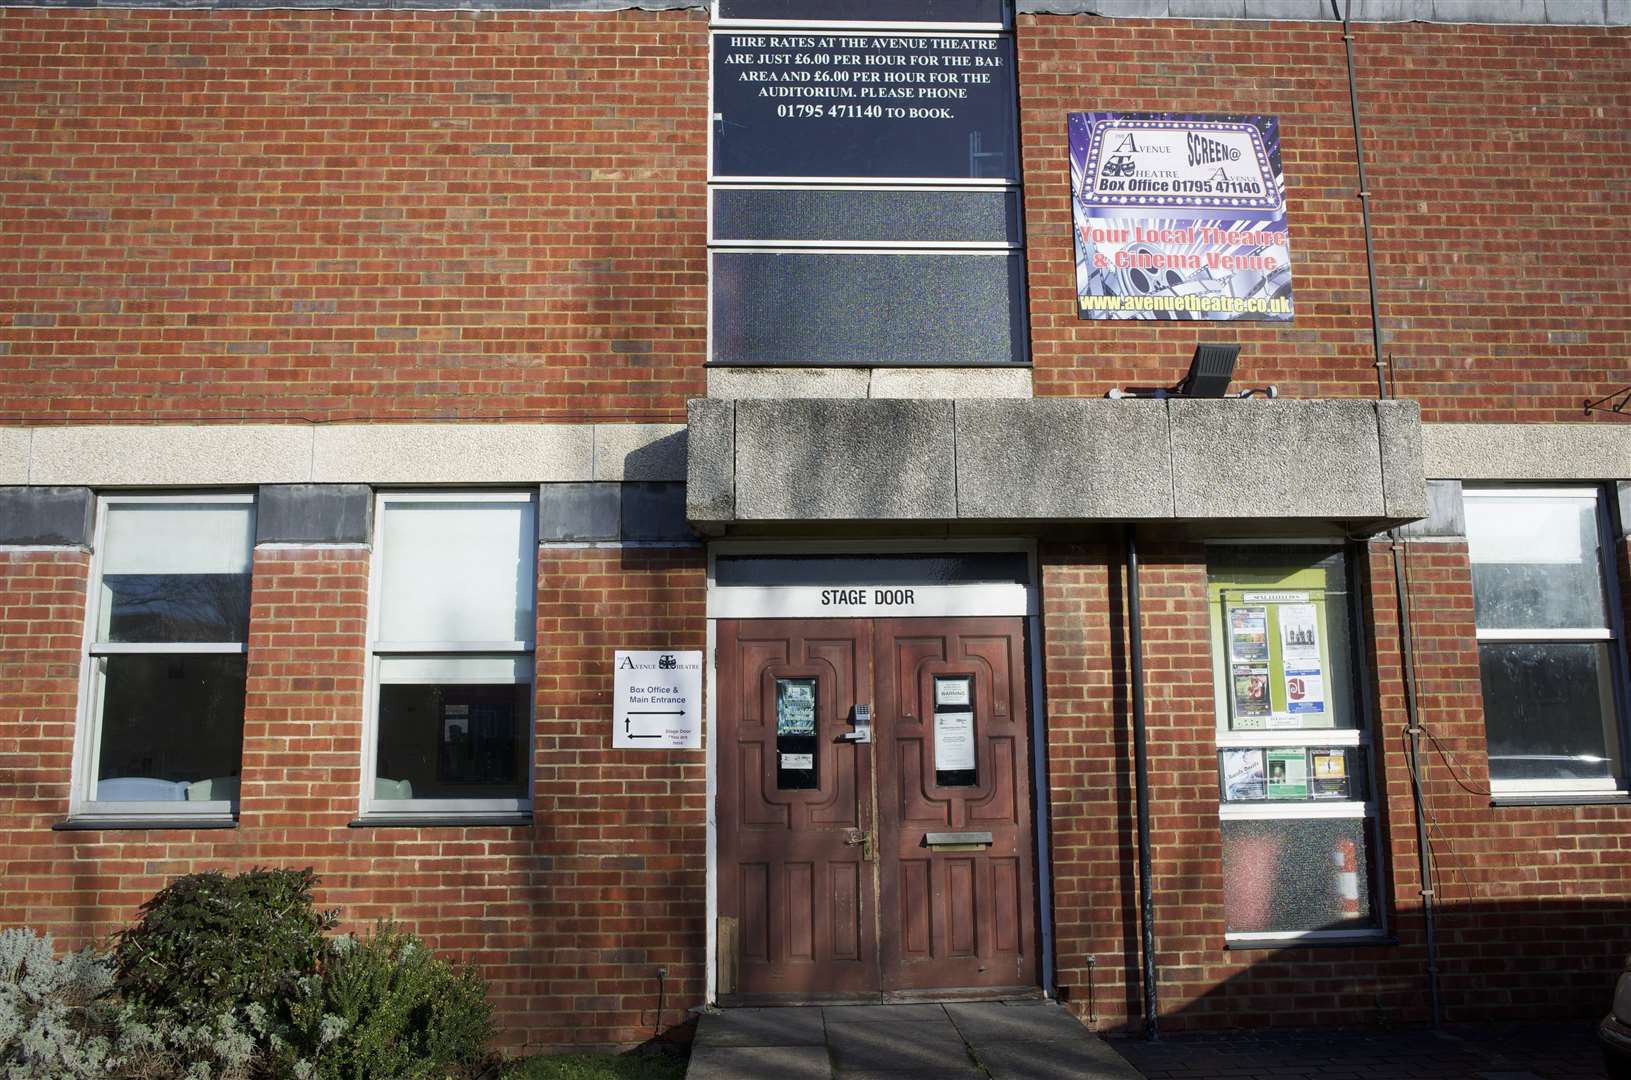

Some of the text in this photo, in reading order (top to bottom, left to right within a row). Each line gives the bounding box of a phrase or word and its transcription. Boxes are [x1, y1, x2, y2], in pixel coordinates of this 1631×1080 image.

[730, 37, 997, 50] HIRE RATES AT THE AVENUE THEATRE
[724, 53, 1004, 67] ARE JUST £6.00 PER HOUR FOR THE BAR
[738, 71, 991, 83] AREA AND £6.00 PER HOUR FOR THE
[758, 86, 968, 99] AUDITORIUM. PLEASE PHONE
[777, 104, 954, 119] 01795 471140 TO BOOK.
[1099, 178, 1261, 194] Box Office 01795 471140
[1080, 226, 1286, 246] Your Local Theatre
[1093, 250, 1277, 271] & Cinema Venue
[1080, 295, 1292, 313] www.avenuetheatre.co.uk
[821, 589, 914, 605] STAGE DOOR
[651, 696, 686, 704] Entrance
